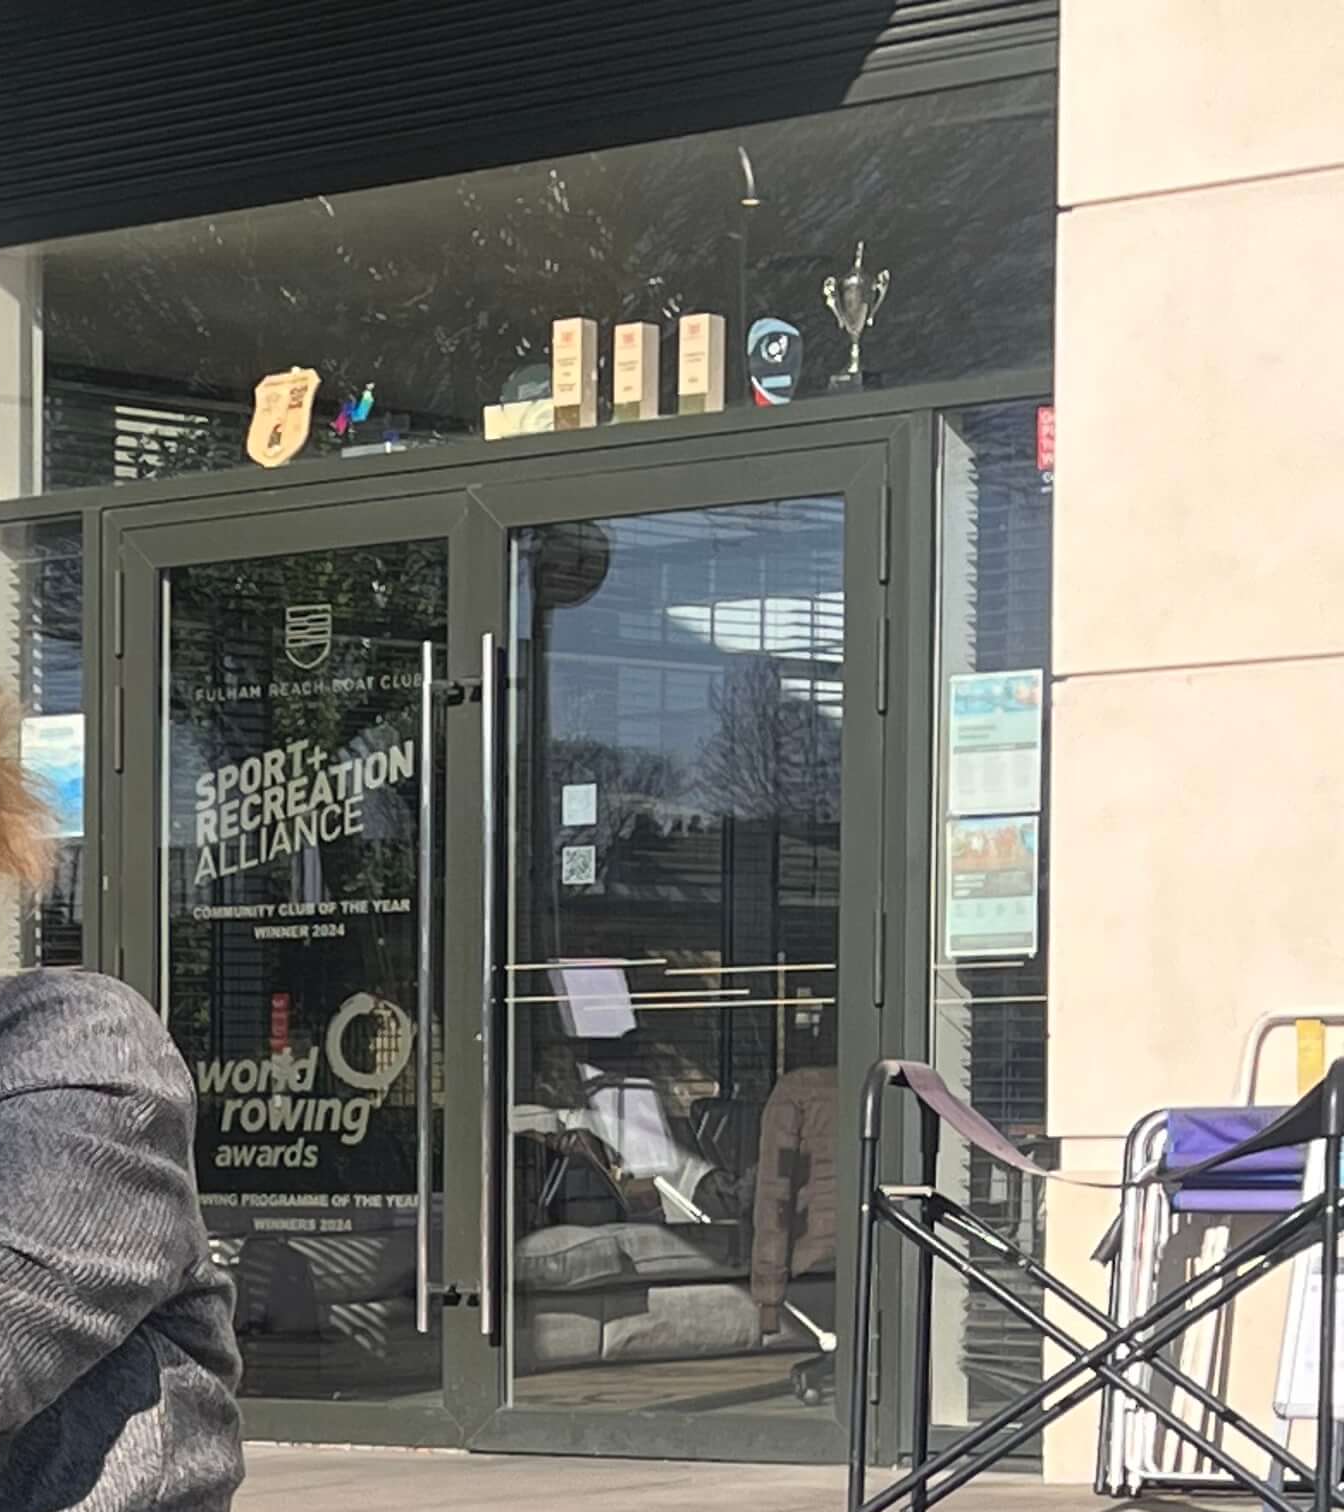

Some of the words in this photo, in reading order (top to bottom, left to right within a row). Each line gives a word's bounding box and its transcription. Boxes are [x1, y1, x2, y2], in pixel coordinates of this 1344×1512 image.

[195, 685, 262, 702] FULHAM
[269, 681, 326, 697] REACH
[332, 676, 375, 693] BOAT
[380, 673, 422, 689] CLUB
[195, 739, 328, 810] SPORT+
[196, 740, 414, 848] RECREATION
[194, 794, 364, 885] ALLIANCE
[192, 904, 275, 921] COMMUNITY
[277, 902, 315, 917] CLUB
[318, 901, 337, 915] OF
[340, 900, 368, 914] THE
[371, 898, 411, 913] YEAR
[254, 925, 310, 940] WINNER
[311, 923, 345, 938] 2024
[196, 1046, 319, 1094] world
[221, 1096, 372, 1145] rowing
[214, 1137, 319, 1168] awards
[241, 1193, 329, 1207] PROGRAMME
[331, 1194, 351, 1207] OF
[354, 1194, 382, 1207] THE
[253, 1217, 317, 1232] WINNERS
